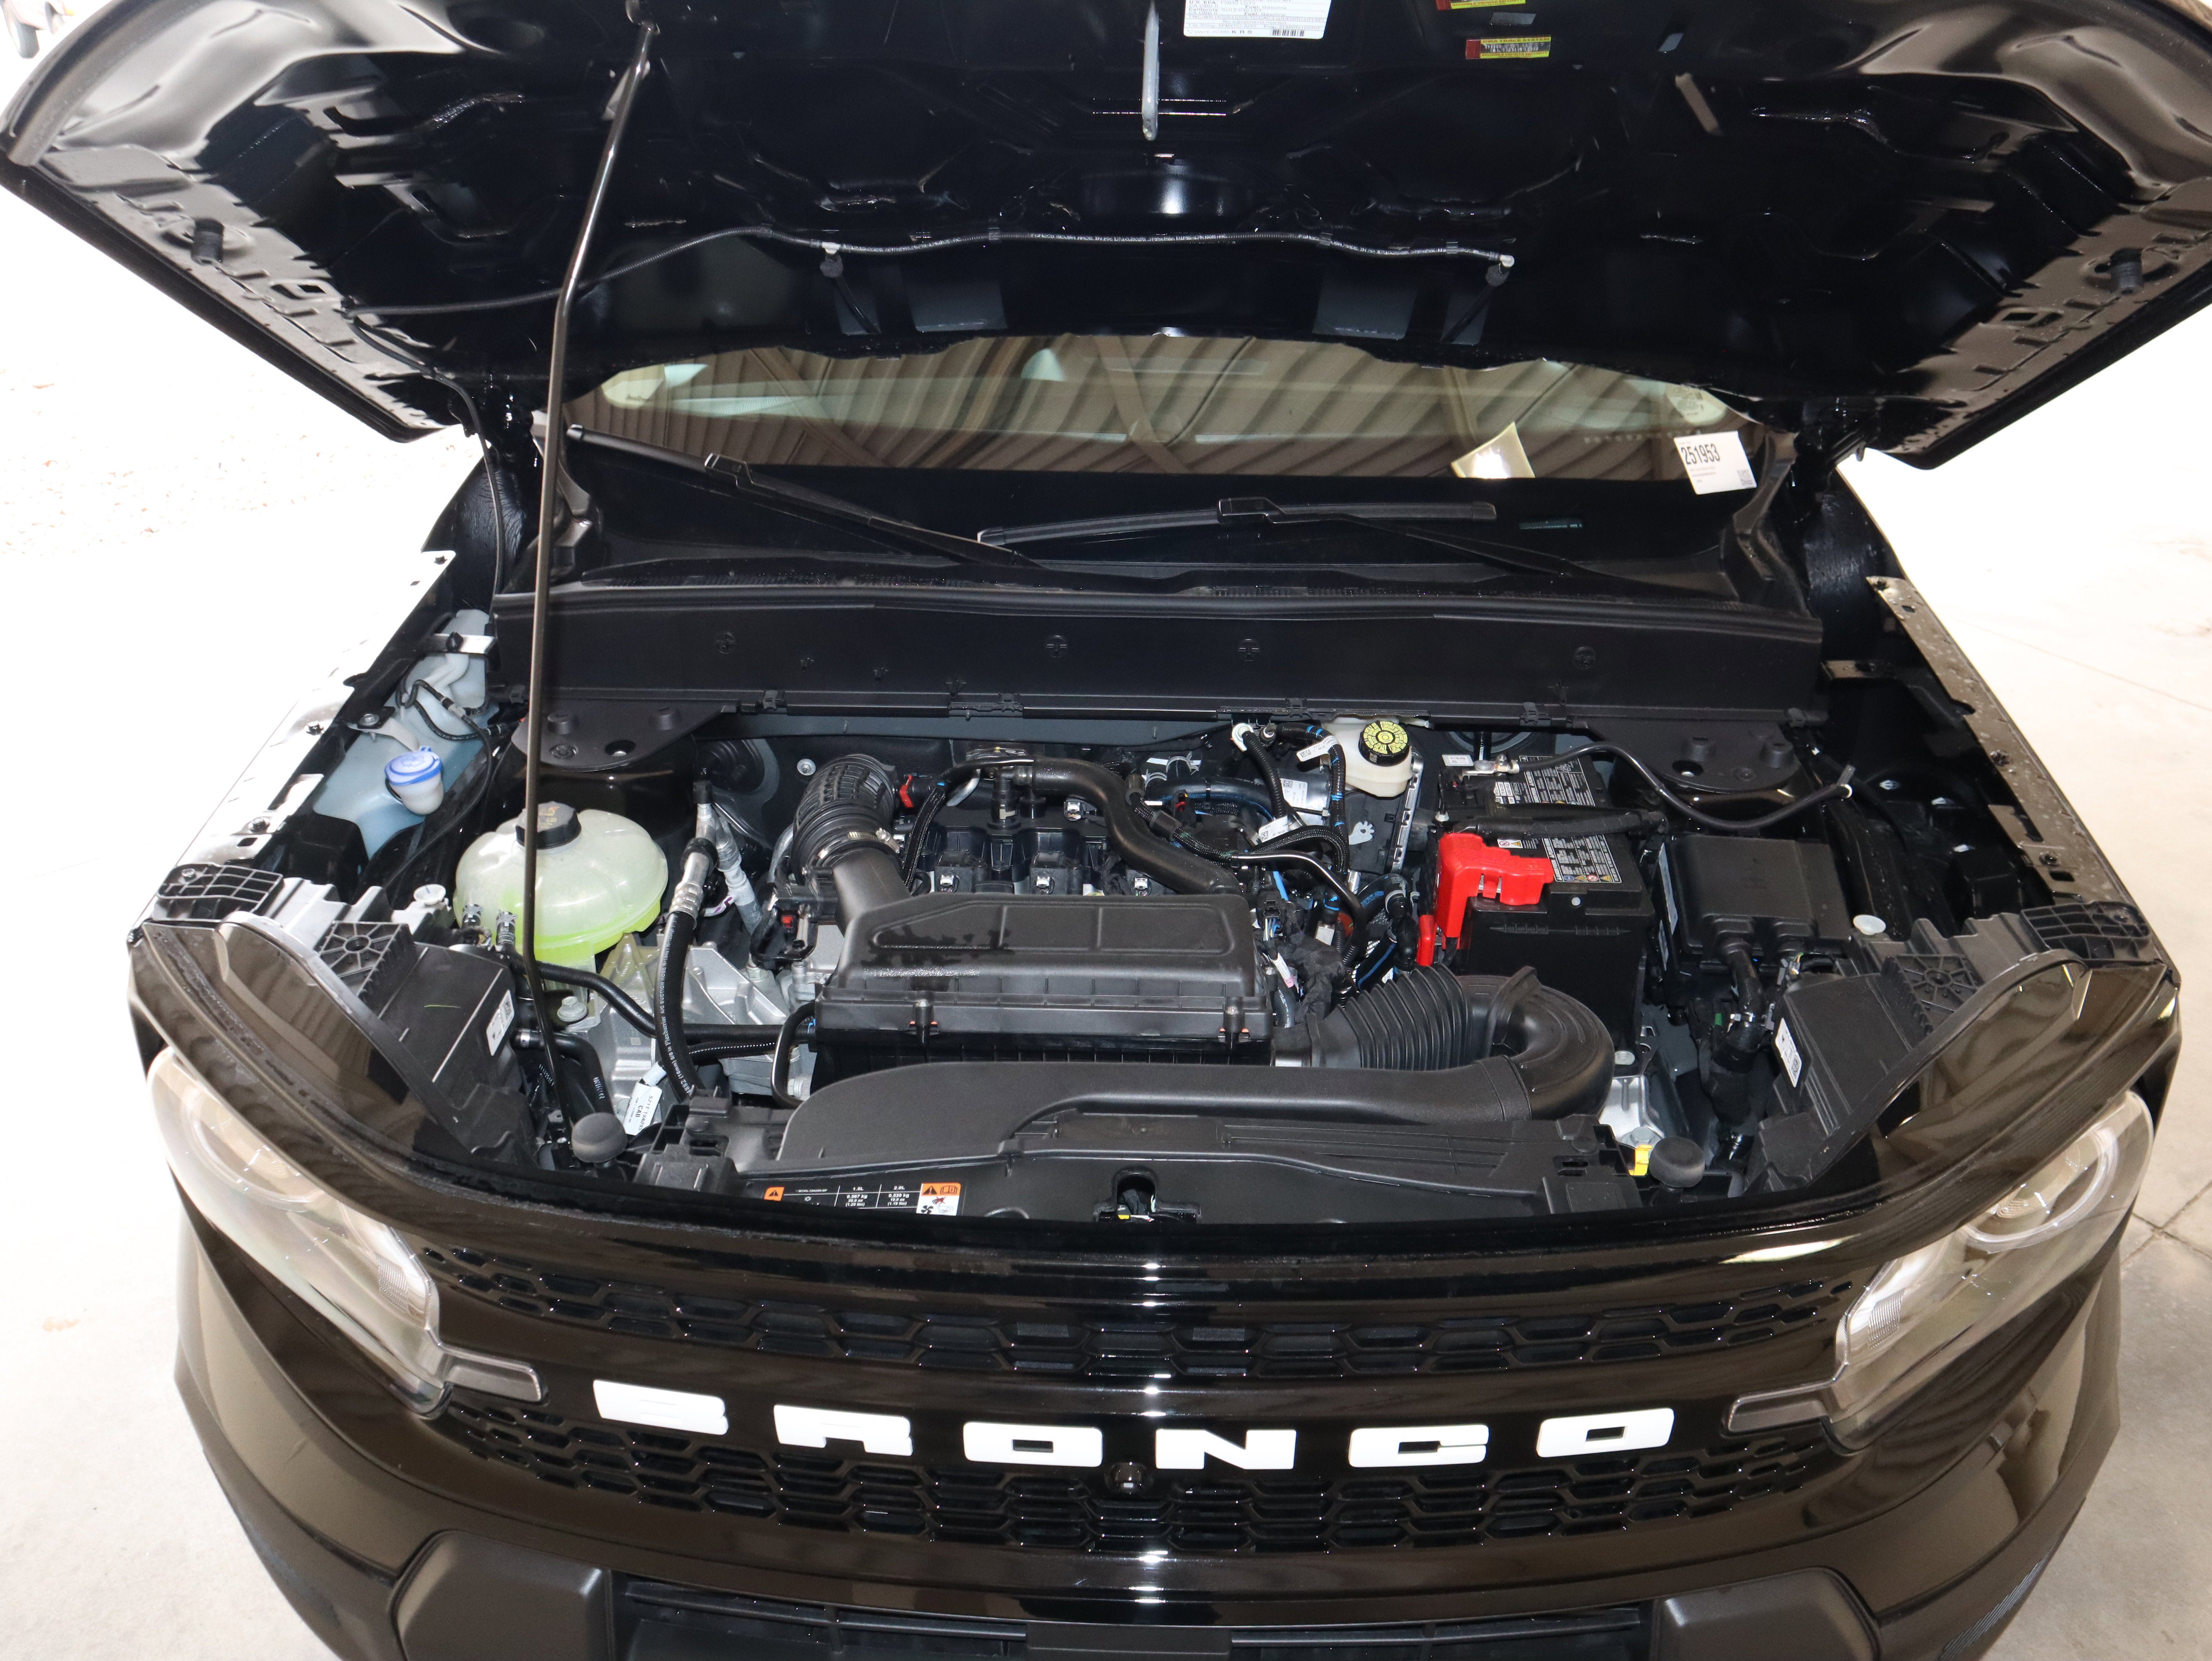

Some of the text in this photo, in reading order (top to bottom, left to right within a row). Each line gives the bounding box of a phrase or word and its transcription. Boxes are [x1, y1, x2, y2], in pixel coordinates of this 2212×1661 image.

[1681, 443, 1720, 465] 251953
[661, 1017, 671, 1046] Flexbarrier
[638, 1112, 648, 1131] 19A095
[592, 1379, 1675, 1470] BRONCO
